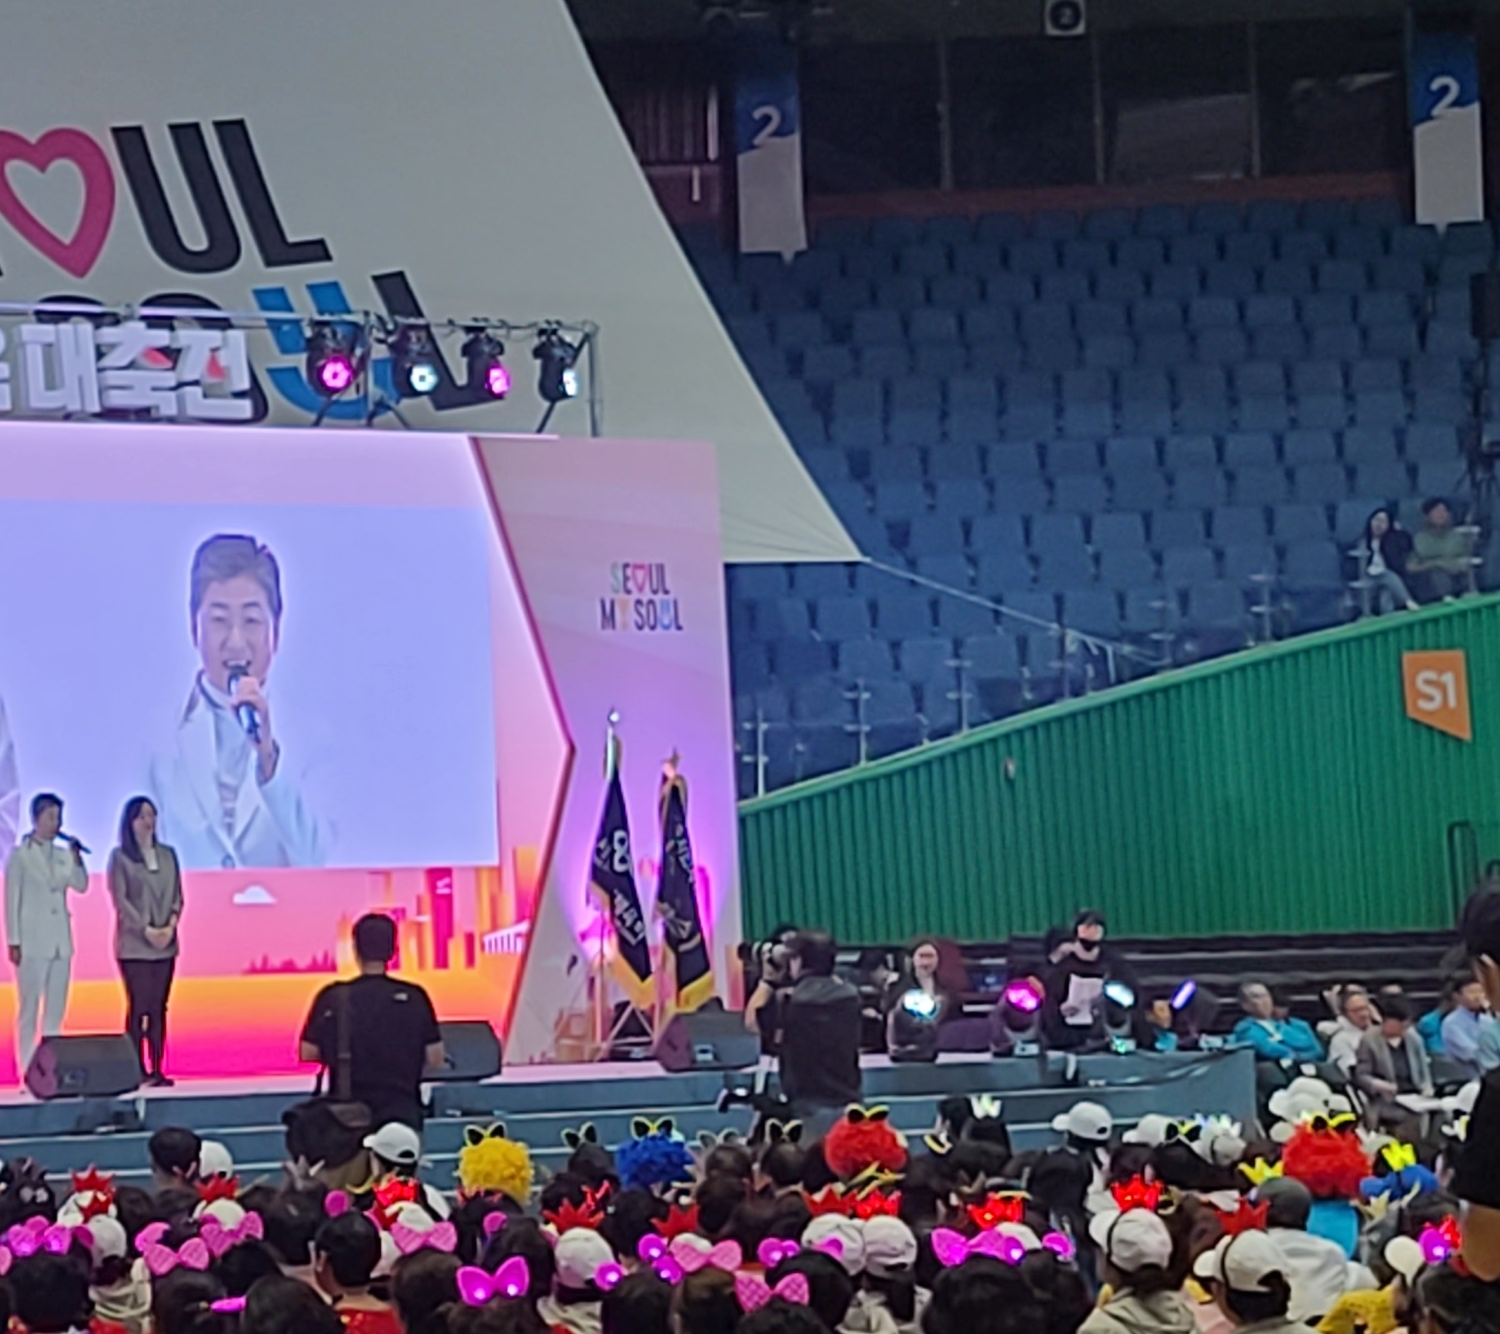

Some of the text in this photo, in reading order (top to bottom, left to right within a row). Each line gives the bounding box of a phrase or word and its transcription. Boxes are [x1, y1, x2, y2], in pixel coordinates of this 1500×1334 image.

[1430, 74, 1461, 117] 2
[752, 104, 781, 147] 2
[600, 597, 684, 631] MY SOUL
[1415, 669, 1458, 711] S1
